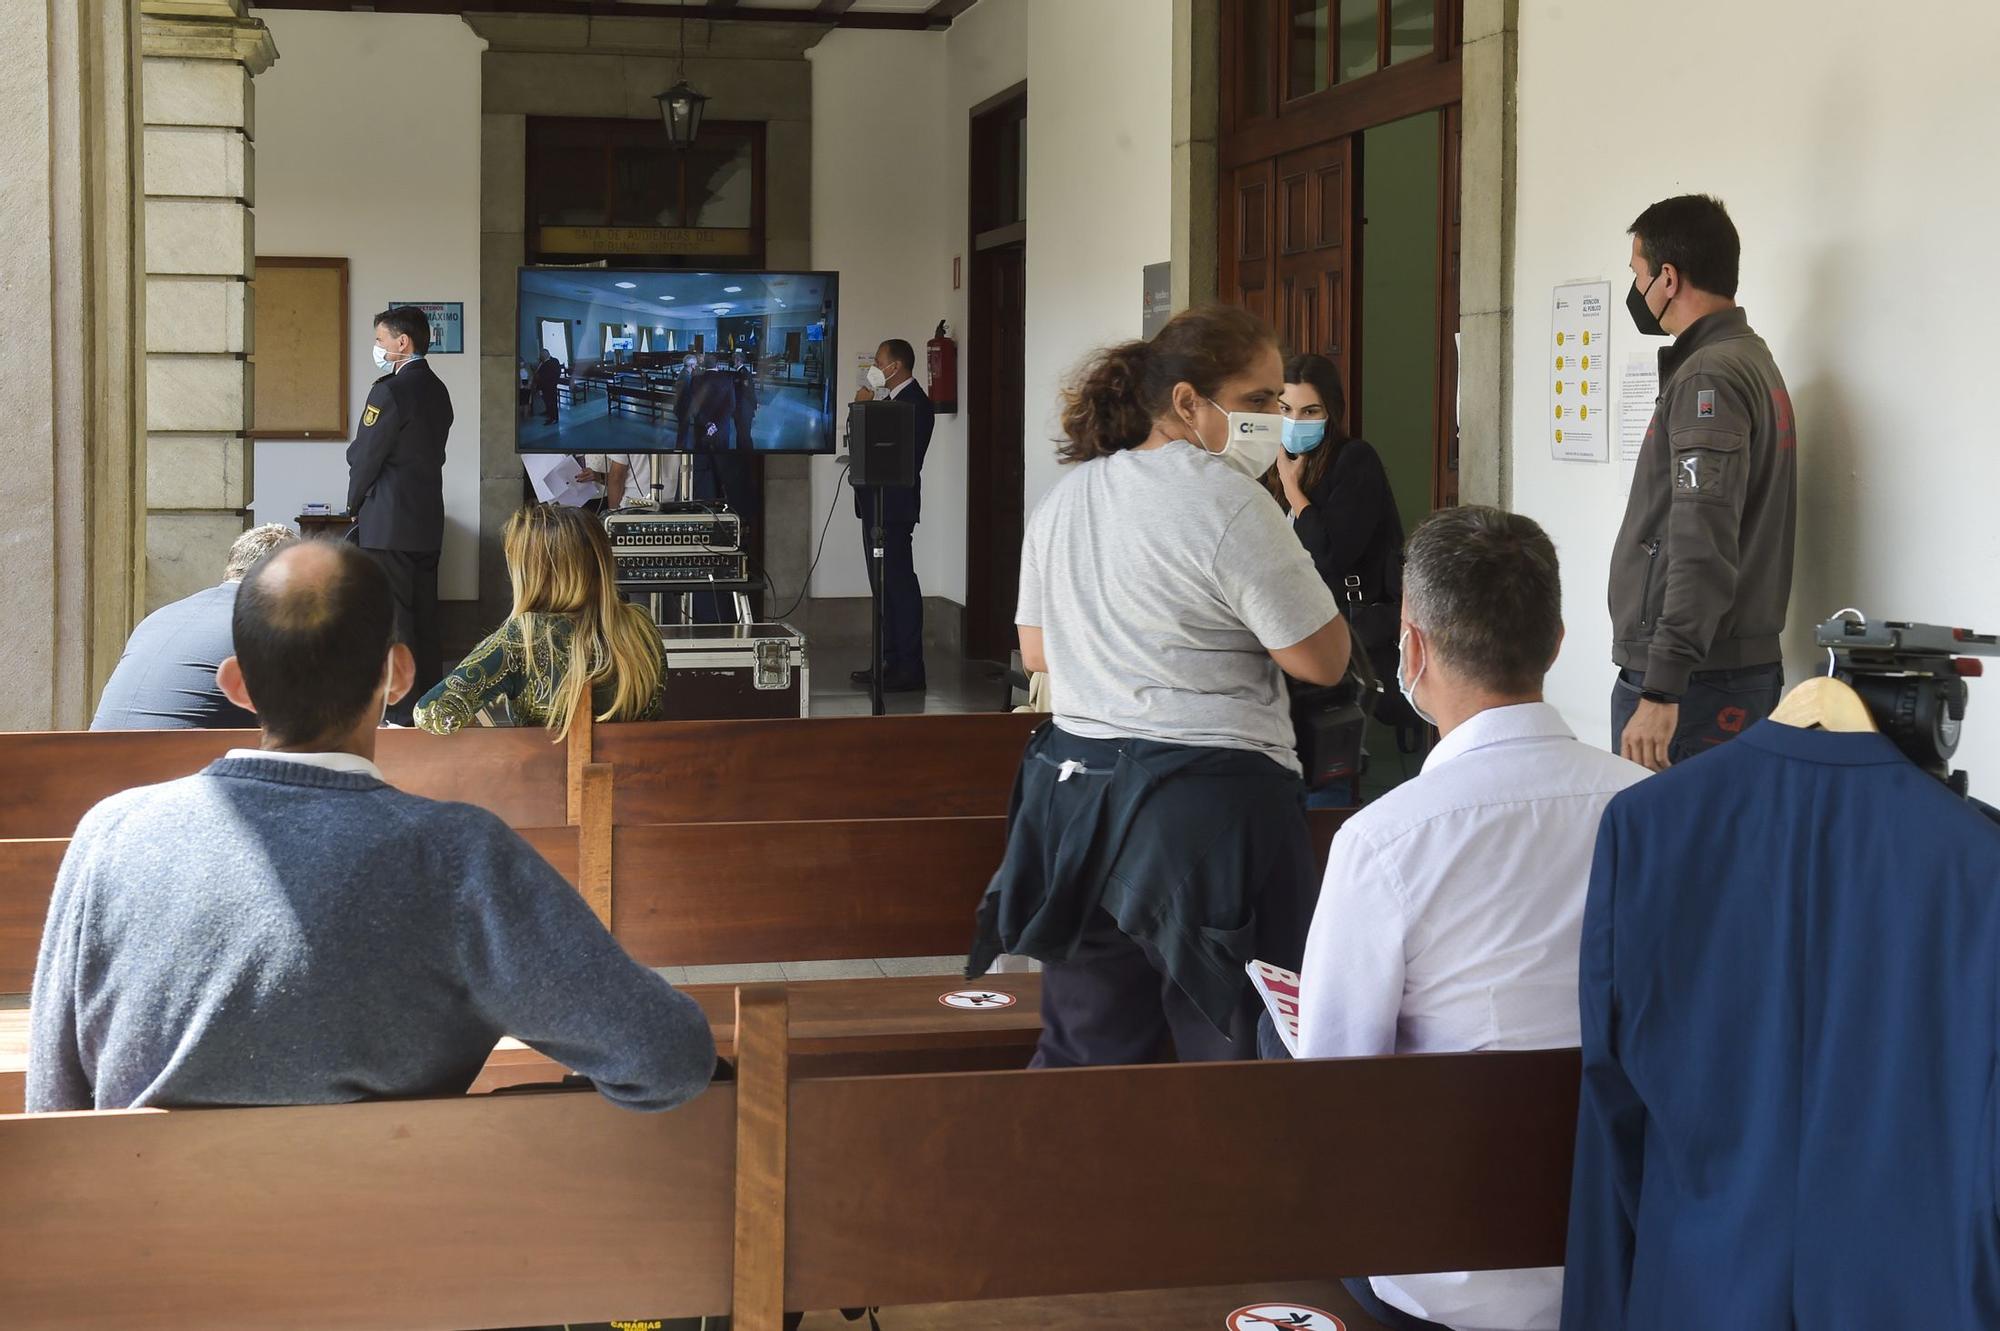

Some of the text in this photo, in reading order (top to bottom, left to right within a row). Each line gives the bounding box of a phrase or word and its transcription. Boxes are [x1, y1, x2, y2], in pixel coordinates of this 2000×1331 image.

[575, 229, 716, 241] SALA DE AUDIENCIAS DEL
